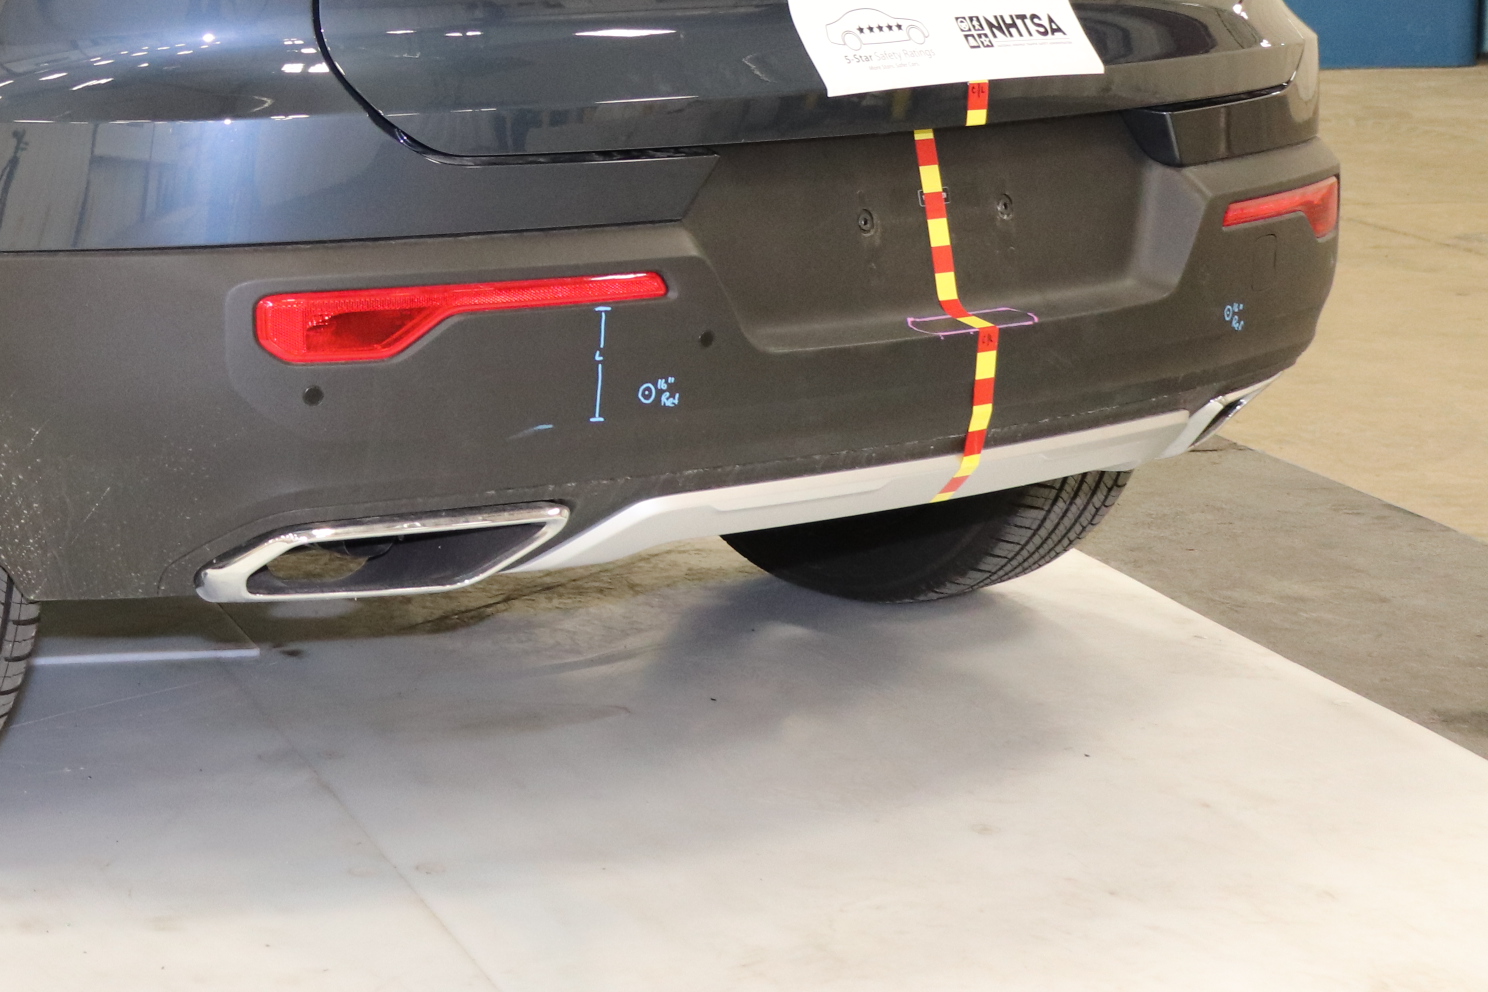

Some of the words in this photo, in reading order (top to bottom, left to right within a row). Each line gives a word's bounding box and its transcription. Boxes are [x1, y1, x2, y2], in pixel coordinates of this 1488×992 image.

[982, 13, 1068, 39] NHTSA
[844, 53, 873, 64] 5-Star
[873, 50, 902, 62] Safety
[902, 48, 936, 59] Ratings
